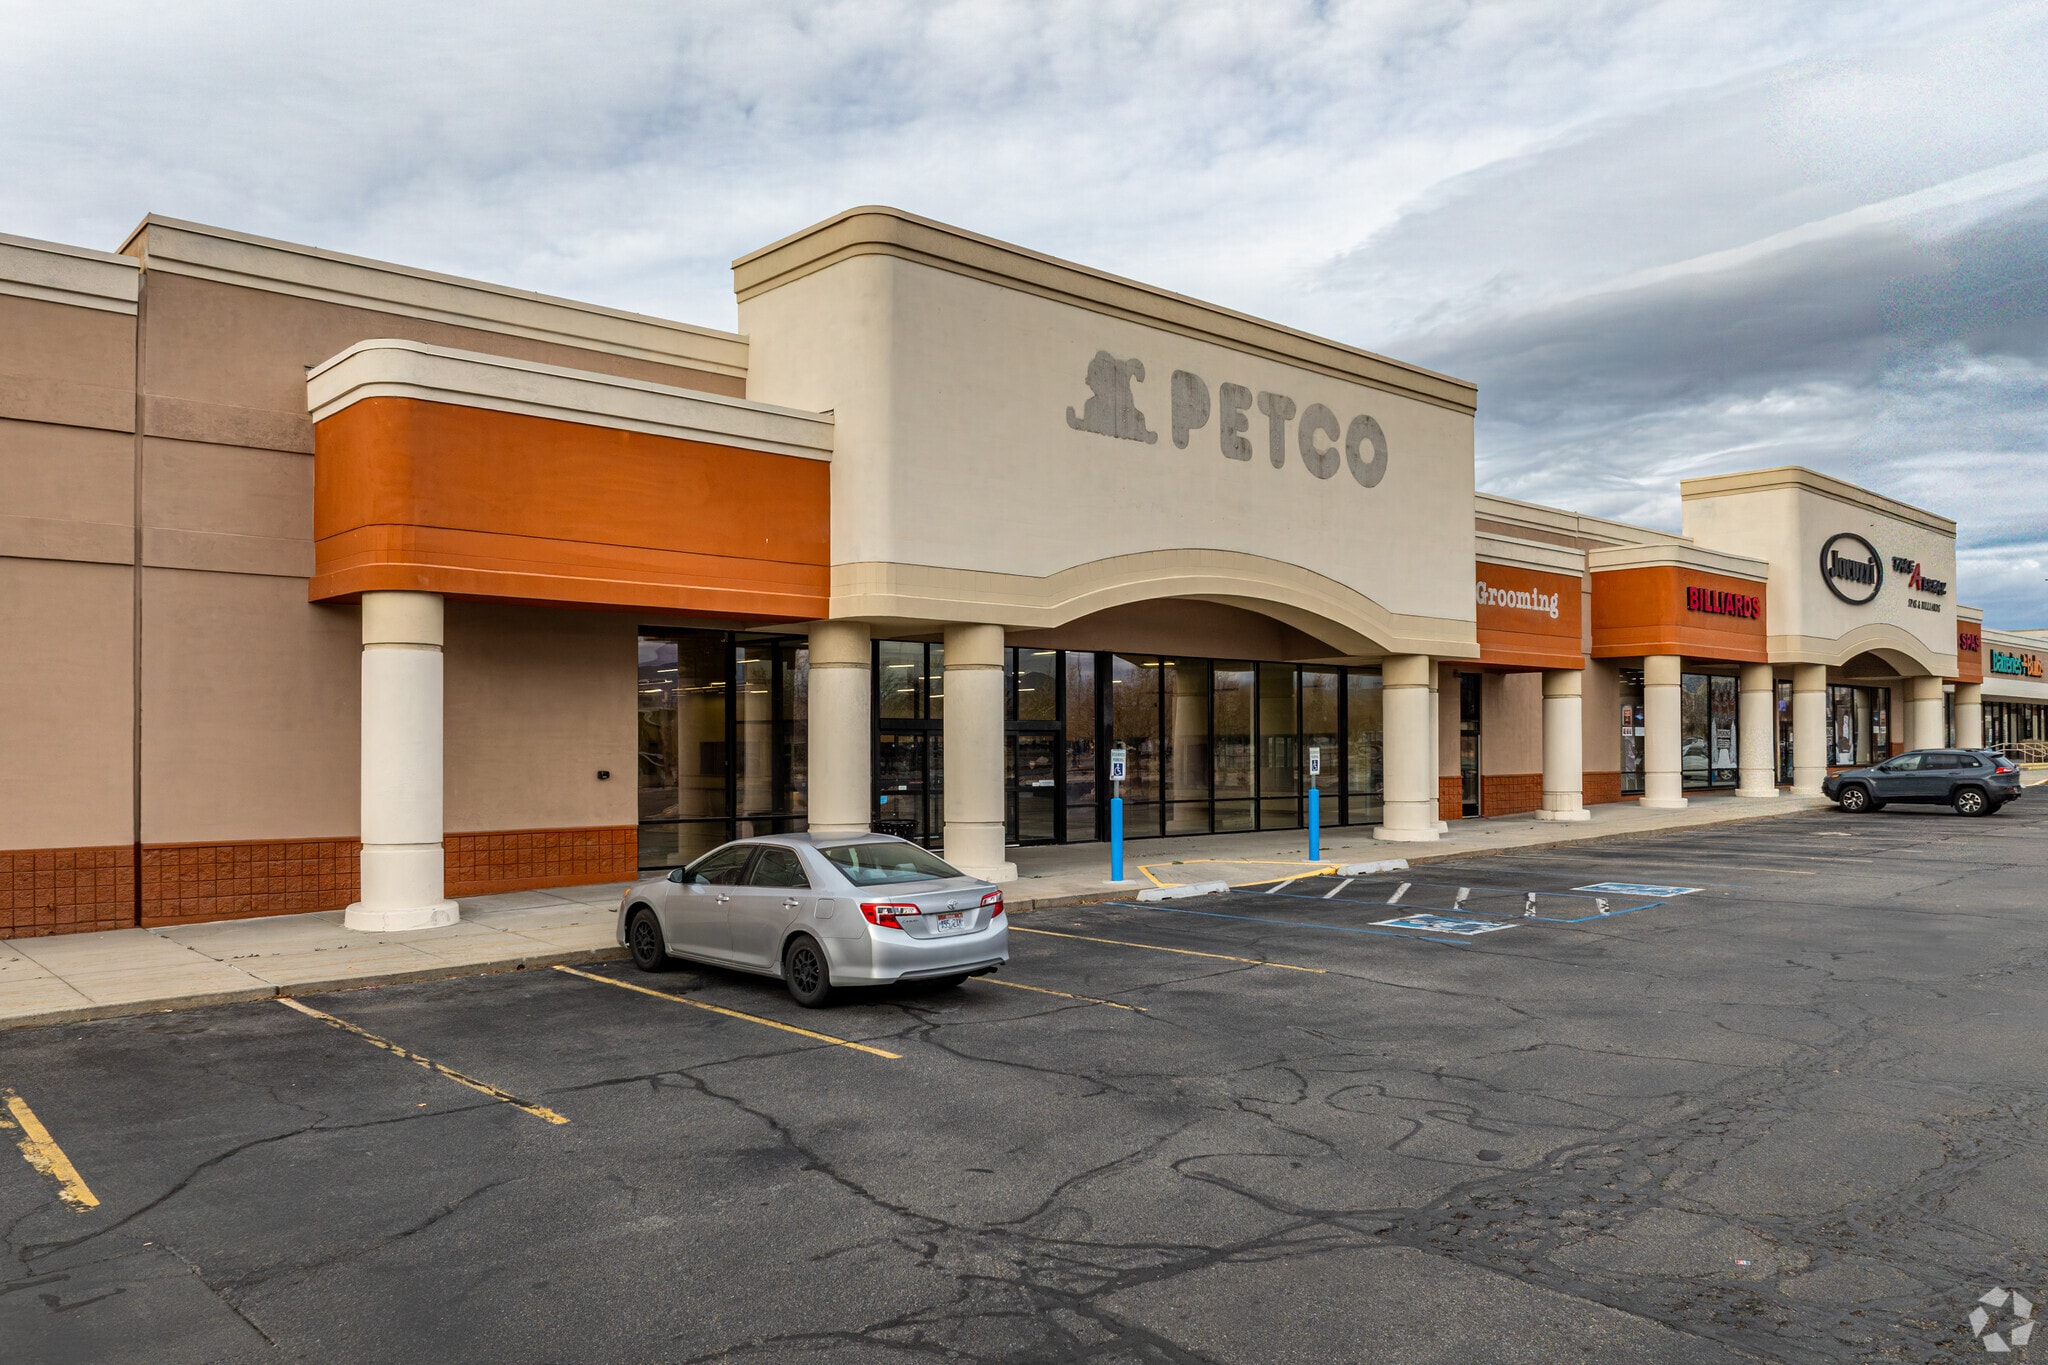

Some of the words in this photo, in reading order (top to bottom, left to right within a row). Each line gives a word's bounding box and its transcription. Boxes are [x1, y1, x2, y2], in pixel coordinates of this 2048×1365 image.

[1171, 369, 1388, 488] PETCO
[1908, 563, 1922, 592] A
[1476, 581, 1559, 619] Grooming
[1687, 586, 1761, 620] BILLIARDS
[1960, 633, 1980, 652] SPAS
